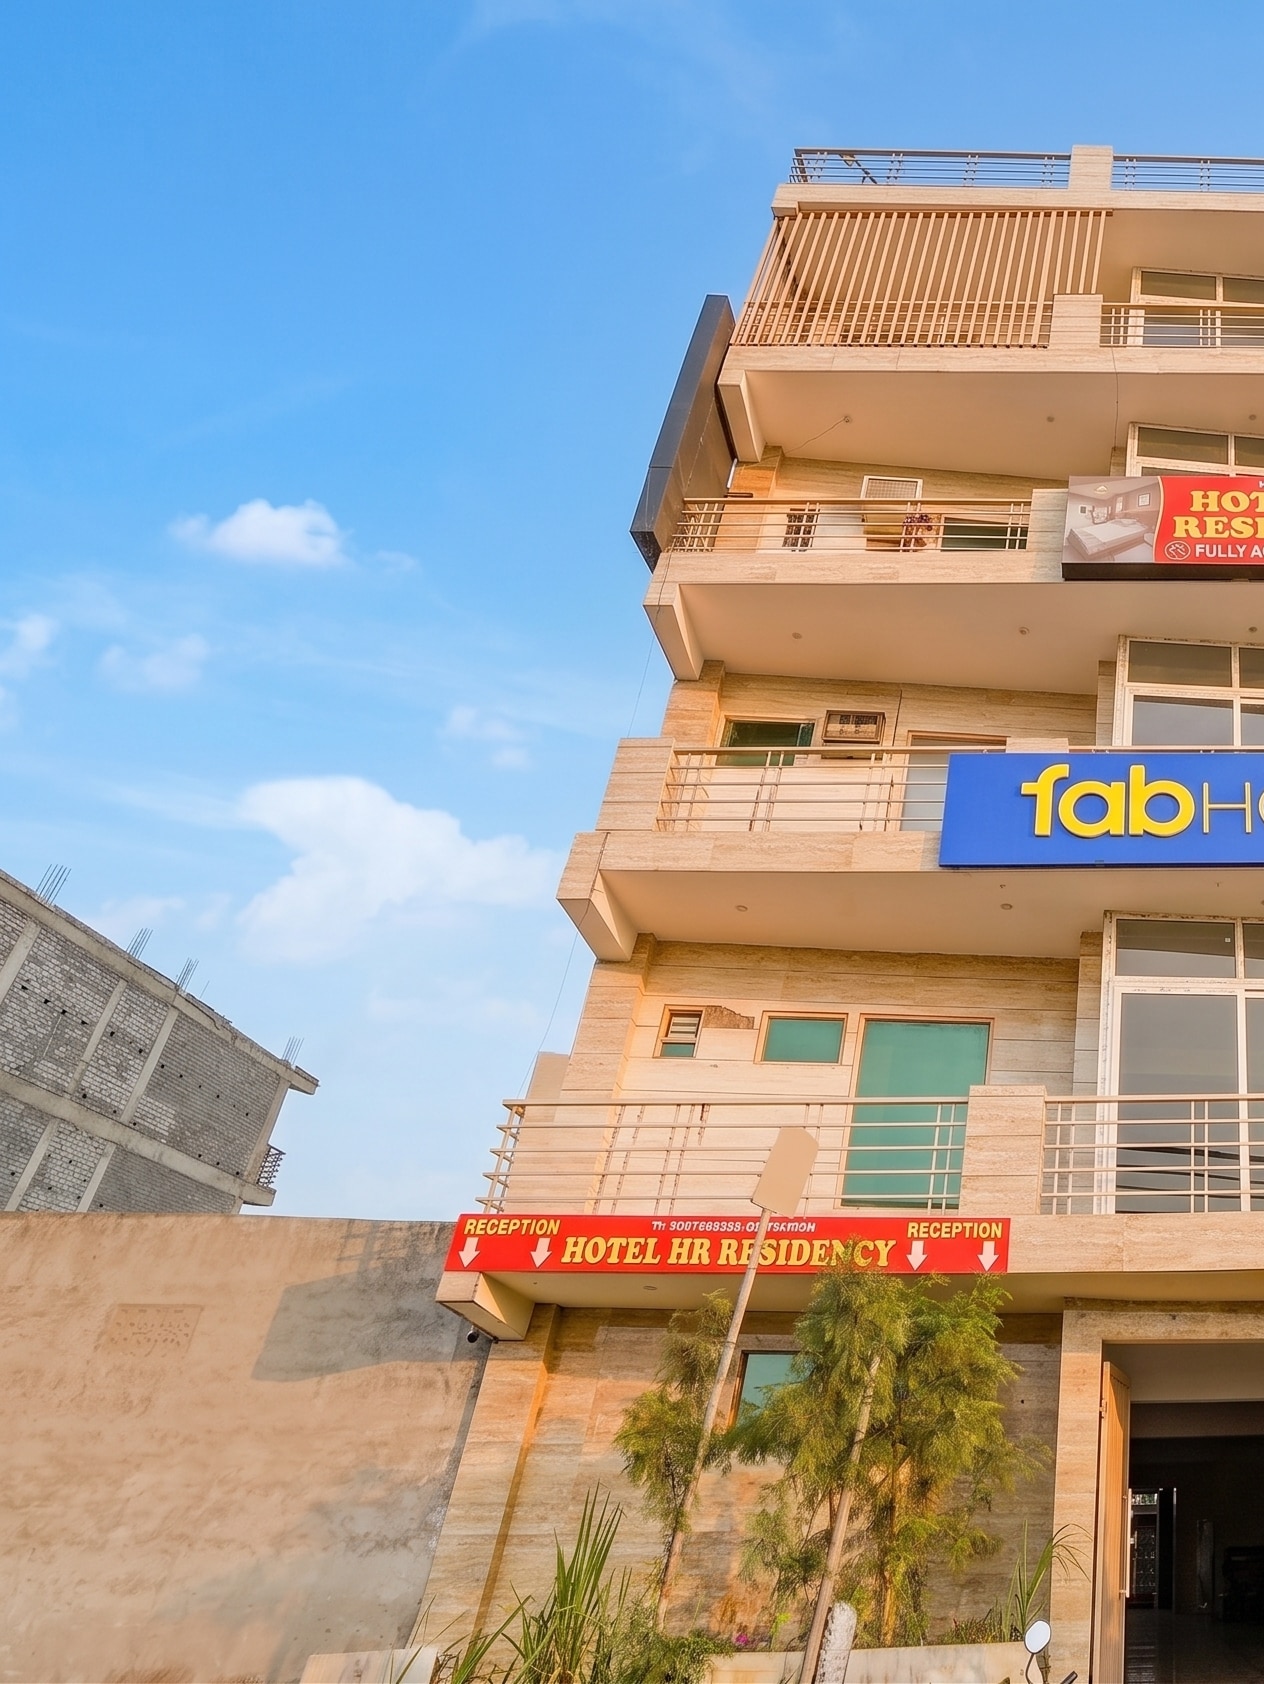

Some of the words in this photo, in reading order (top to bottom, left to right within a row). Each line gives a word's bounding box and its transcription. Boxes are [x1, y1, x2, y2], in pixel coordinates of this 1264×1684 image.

[1195, 542, 1246, 558] FULLY
[463, 1218, 561, 1236] RECEPTION
[907, 1221, 1003, 1240] RECEPTION
[560, 1236, 661, 1265] HOTEL
[667, 1237, 711, 1266] HR
[716, 1237, 897, 1268] RESIDENCY
